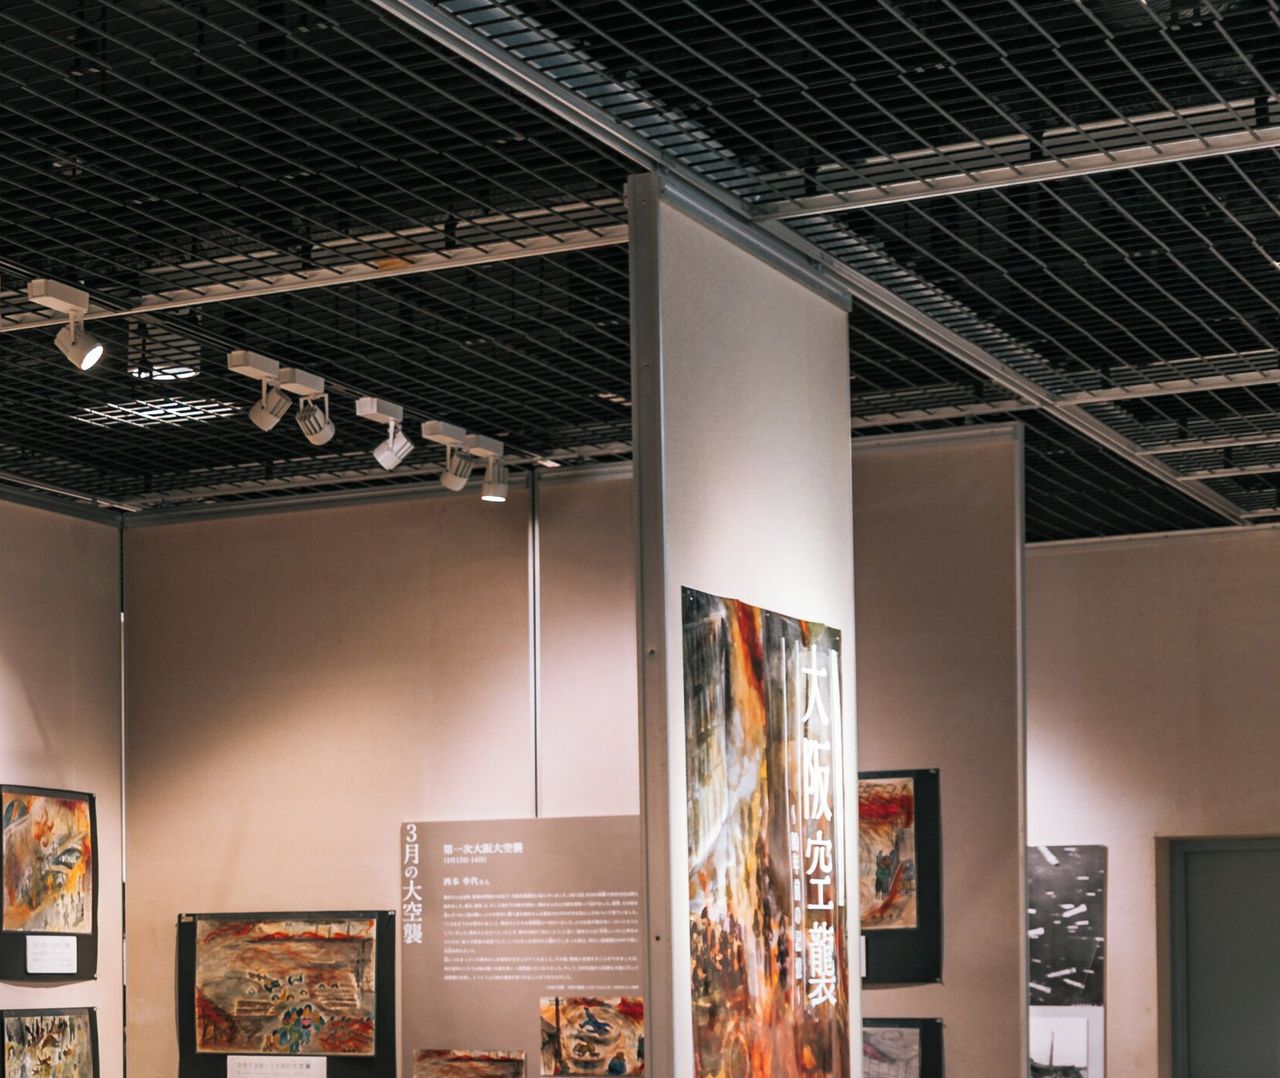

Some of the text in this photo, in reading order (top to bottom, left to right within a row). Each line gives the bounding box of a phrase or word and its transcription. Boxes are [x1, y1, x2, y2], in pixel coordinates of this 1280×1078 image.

[402, 824, 423, 944] 3月の大空襲
[443, 842, 524, 855] 第一次大阪大空襲
[801, 643, 838, 1007] 大阪空襲
